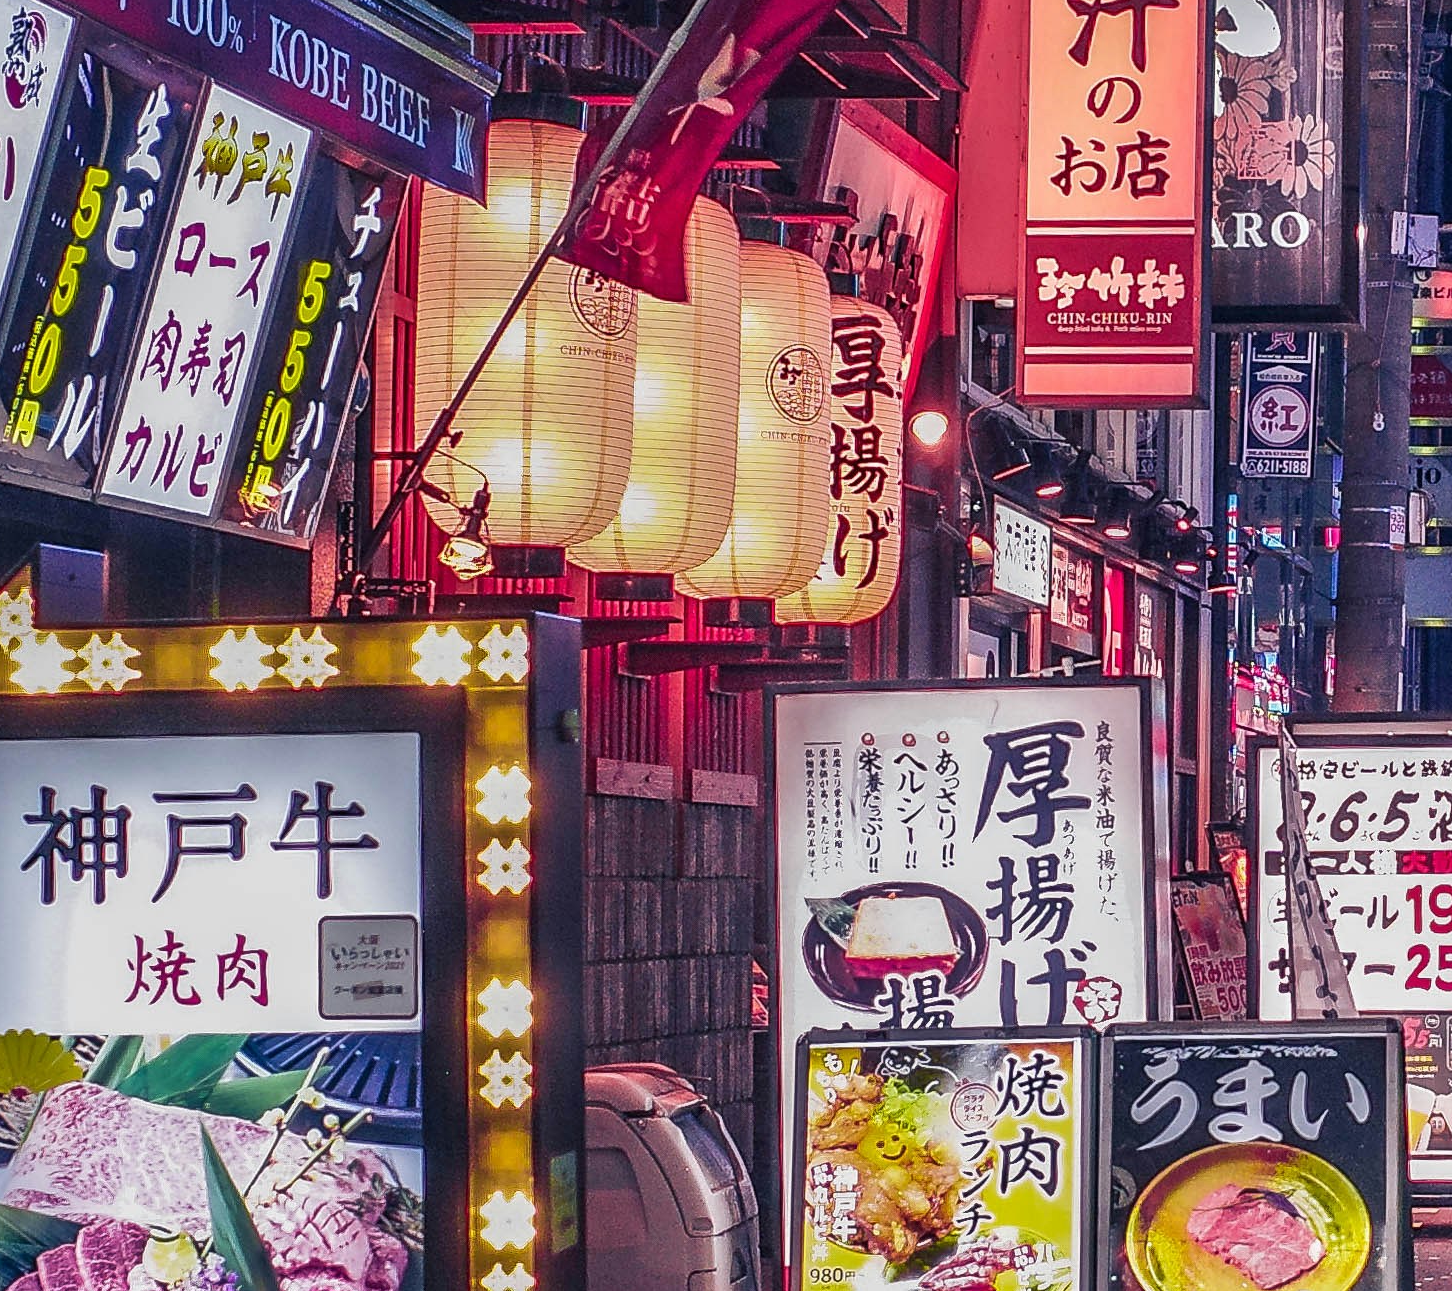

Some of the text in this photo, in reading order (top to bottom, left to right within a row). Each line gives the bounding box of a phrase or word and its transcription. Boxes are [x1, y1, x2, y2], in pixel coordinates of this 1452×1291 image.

[269, 13, 350, 113] KOBE
[361, 62, 431, 149] BEEF
[193, 111, 296, 223] 神戸牛
[1050, 131, 1172, 200] お店
[12, 166, 112, 450] 550円
[47, 83, 172, 464] 生ビール
[173, 222, 273, 307] ロース
[138, 309, 248, 408] 肉寿司
[281, 186, 383, 525] チューハイ
[1046, 312, 1173, 325] CHIN-CHIKU-RIN
[116, 415, 223, 499] カルビ
[1259, 395, 1299, 435] 紅
[19, 780, 380, 906] 神戸牛
[972, 720, 1098, 1027] 厚揚げ
[123, 928, 271, 1008] 焼肉
[995, 1052, 1066, 1198] 焼肉
[1129, 1058, 1370, 1151] うまい
[956, 1129, 995, 1236] ランチ
